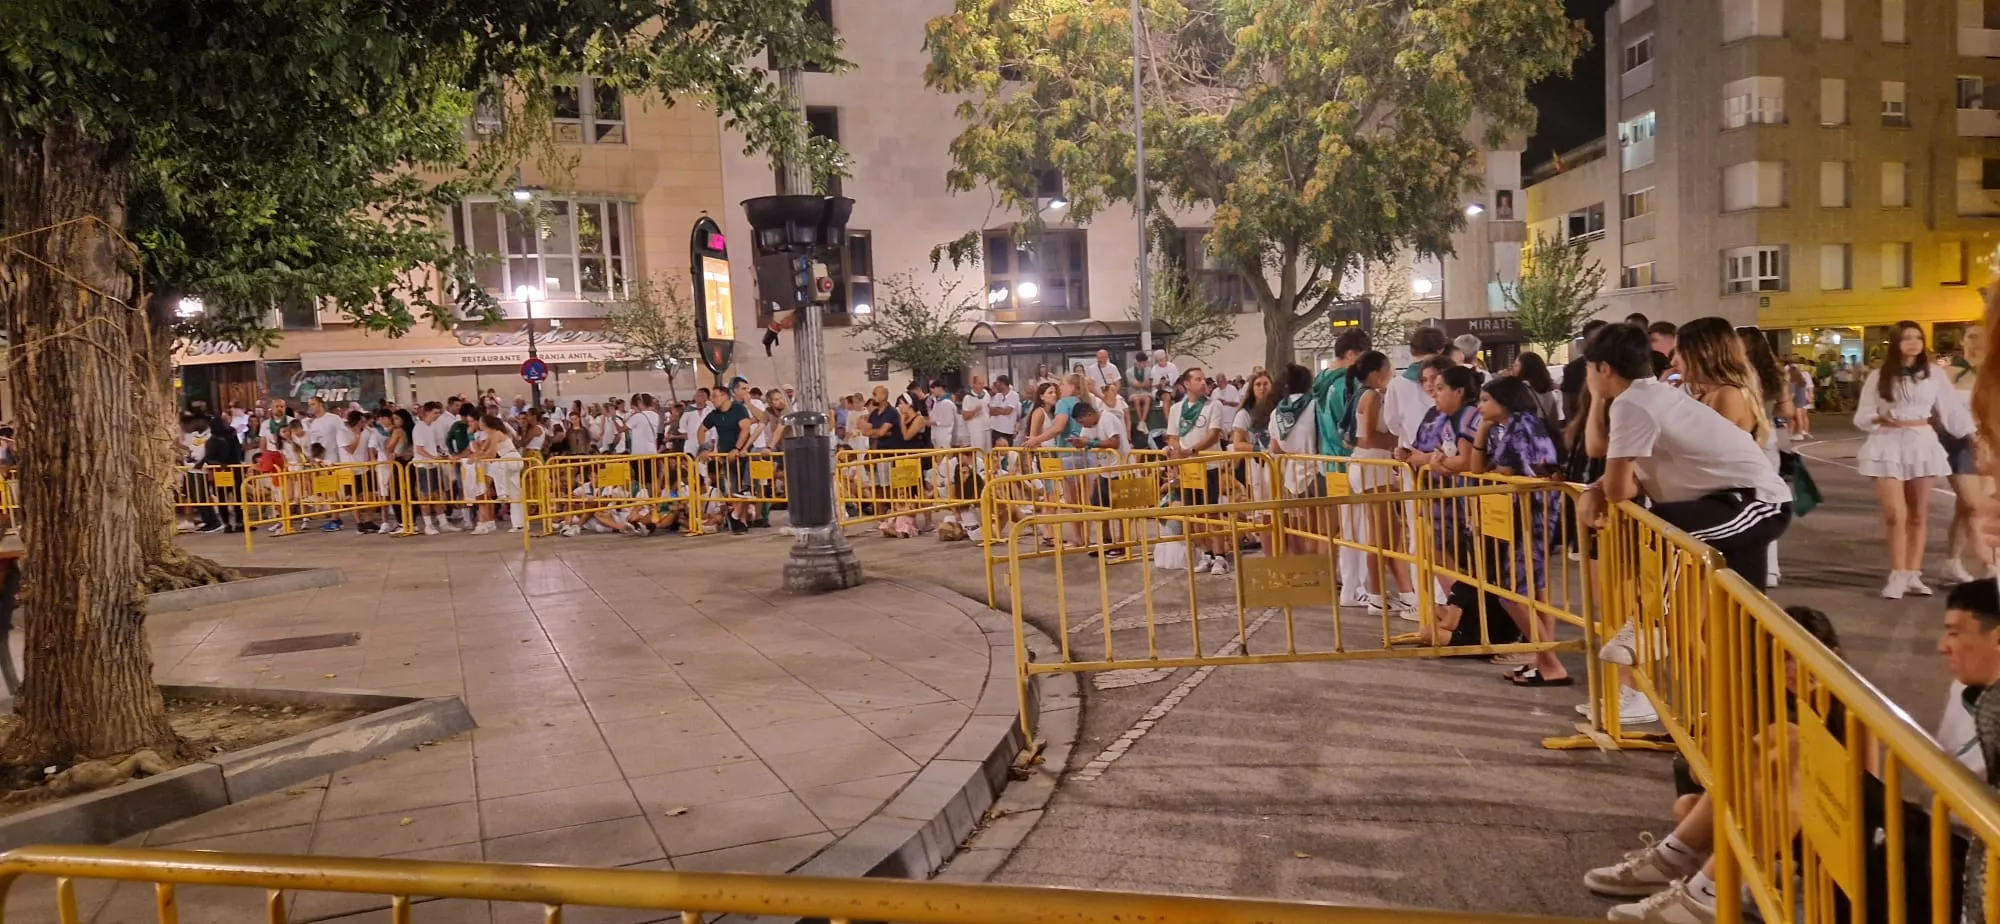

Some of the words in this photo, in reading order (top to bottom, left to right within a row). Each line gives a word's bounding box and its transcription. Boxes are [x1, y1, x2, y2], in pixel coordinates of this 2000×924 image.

[461, 354, 521, 363] RESTAURANTE
[538, 351, 566, 360] RANJA
[567, 351, 593, 360] ANITA
